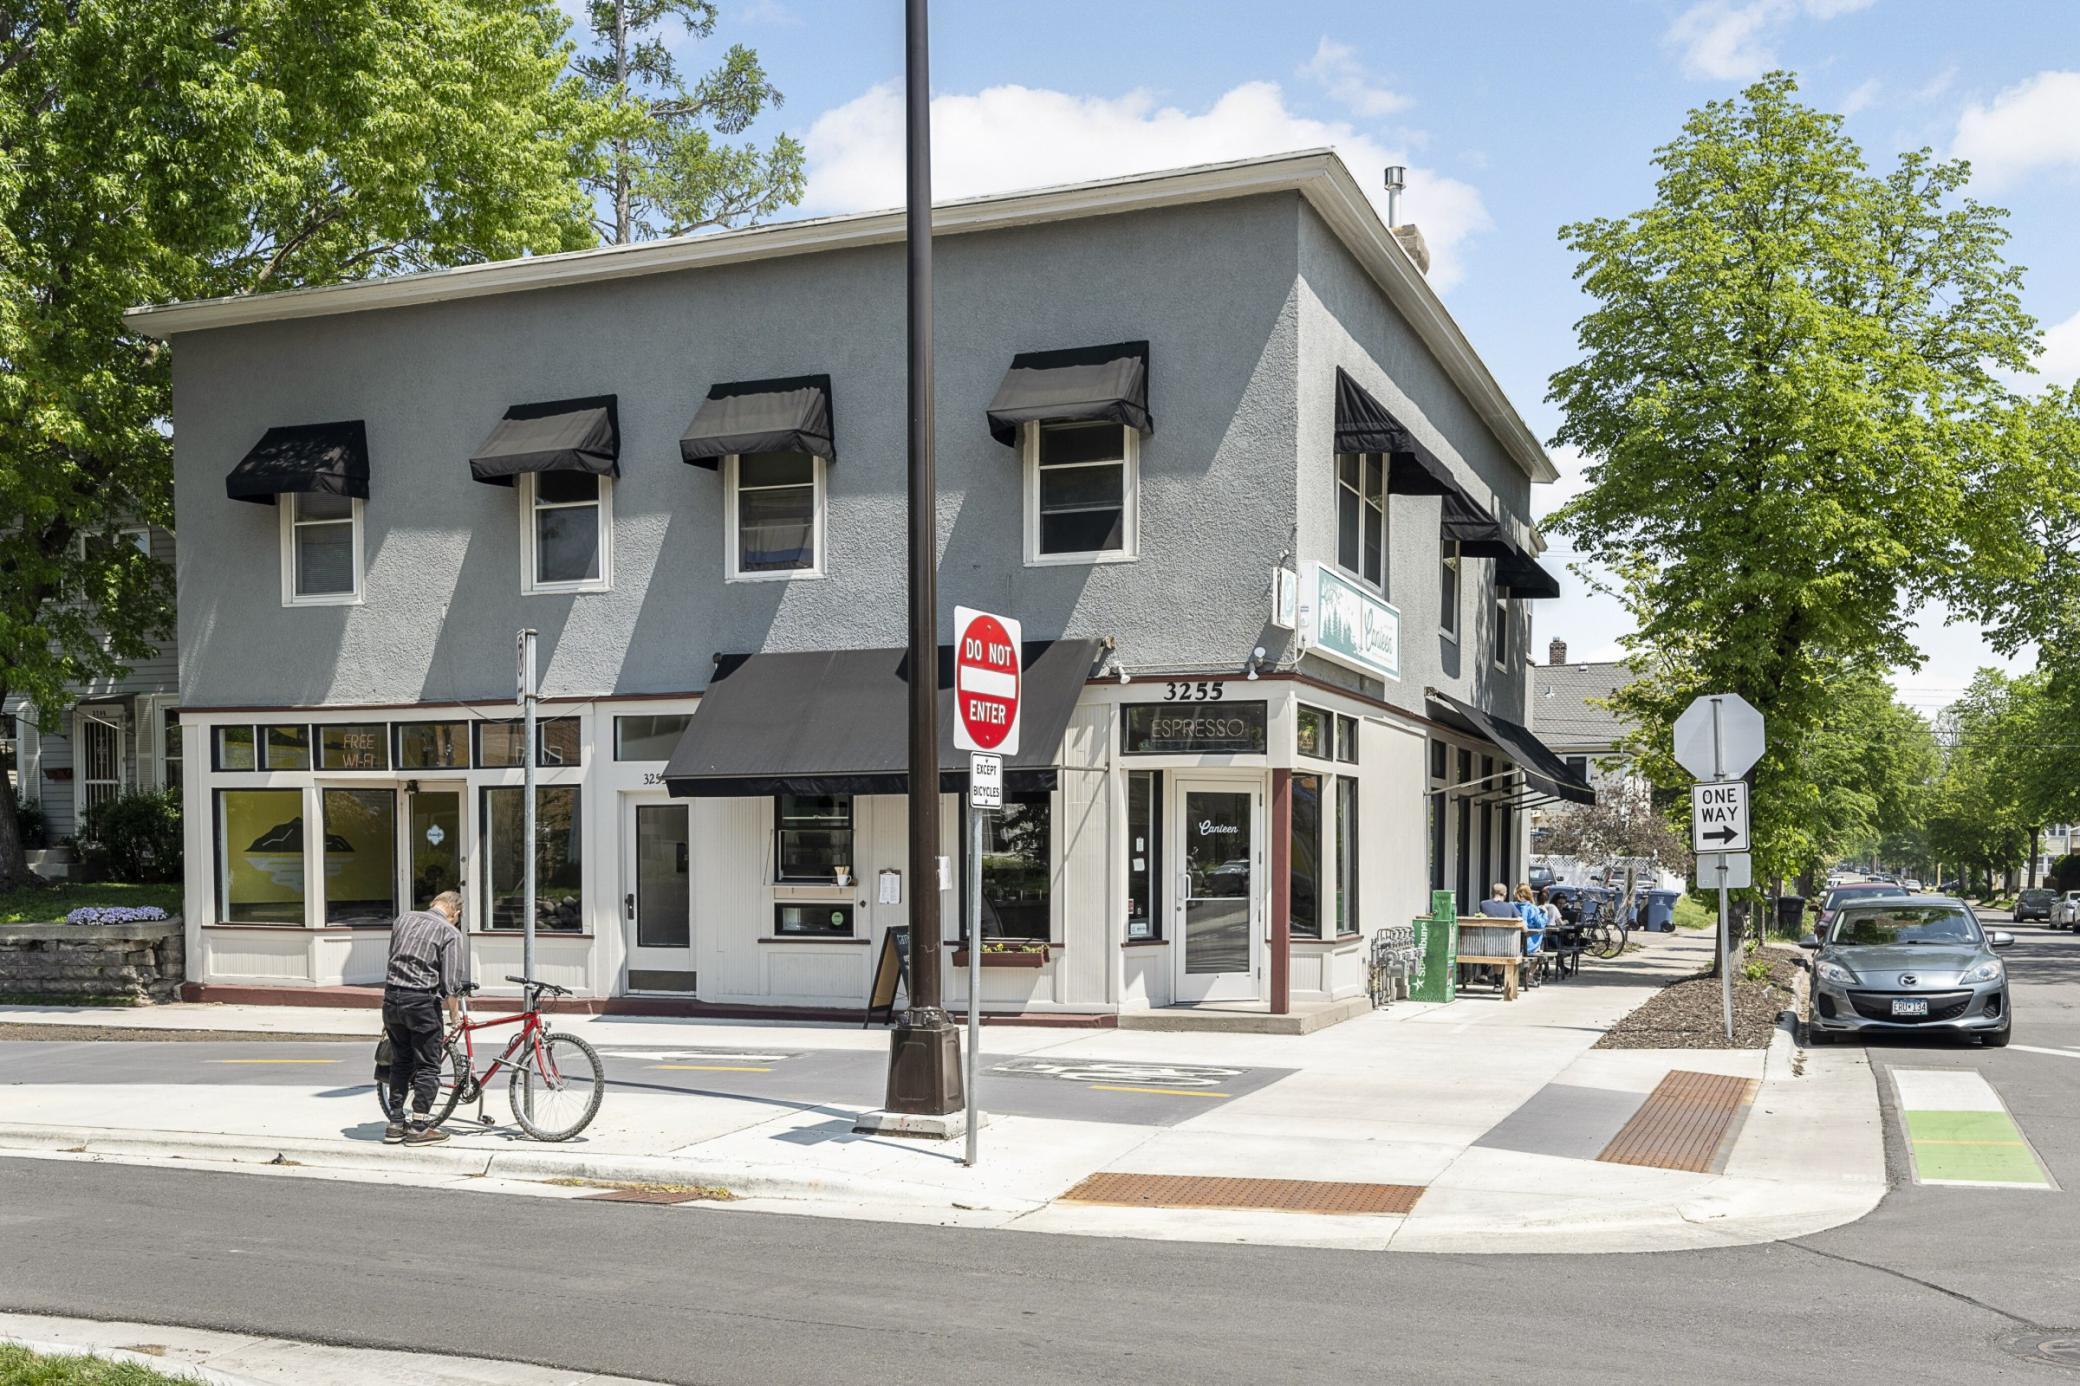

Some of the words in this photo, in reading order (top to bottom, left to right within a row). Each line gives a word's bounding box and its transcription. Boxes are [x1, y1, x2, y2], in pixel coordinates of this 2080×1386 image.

[966, 637, 983, 661] DO
[989, 642, 1012, 667] NOT
[1163, 681, 1224, 701] 3255
[969, 699, 1006, 725] ENTER
[1152, 718, 1245, 738] ESPRESSO
[343, 734, 375, 749] FREE
[342, 753, 375, 768] WI-FI
[976, 763, 997, 776] EXCEPT
[643, 773, 667, 785] 325
[973, 785, 1000, 798] BICYCLES
[1702, 788, 1737, 804] ONE
[1701, 806, 1738, 823] WAY
[1198, 819, 1239, 836] Canteen
